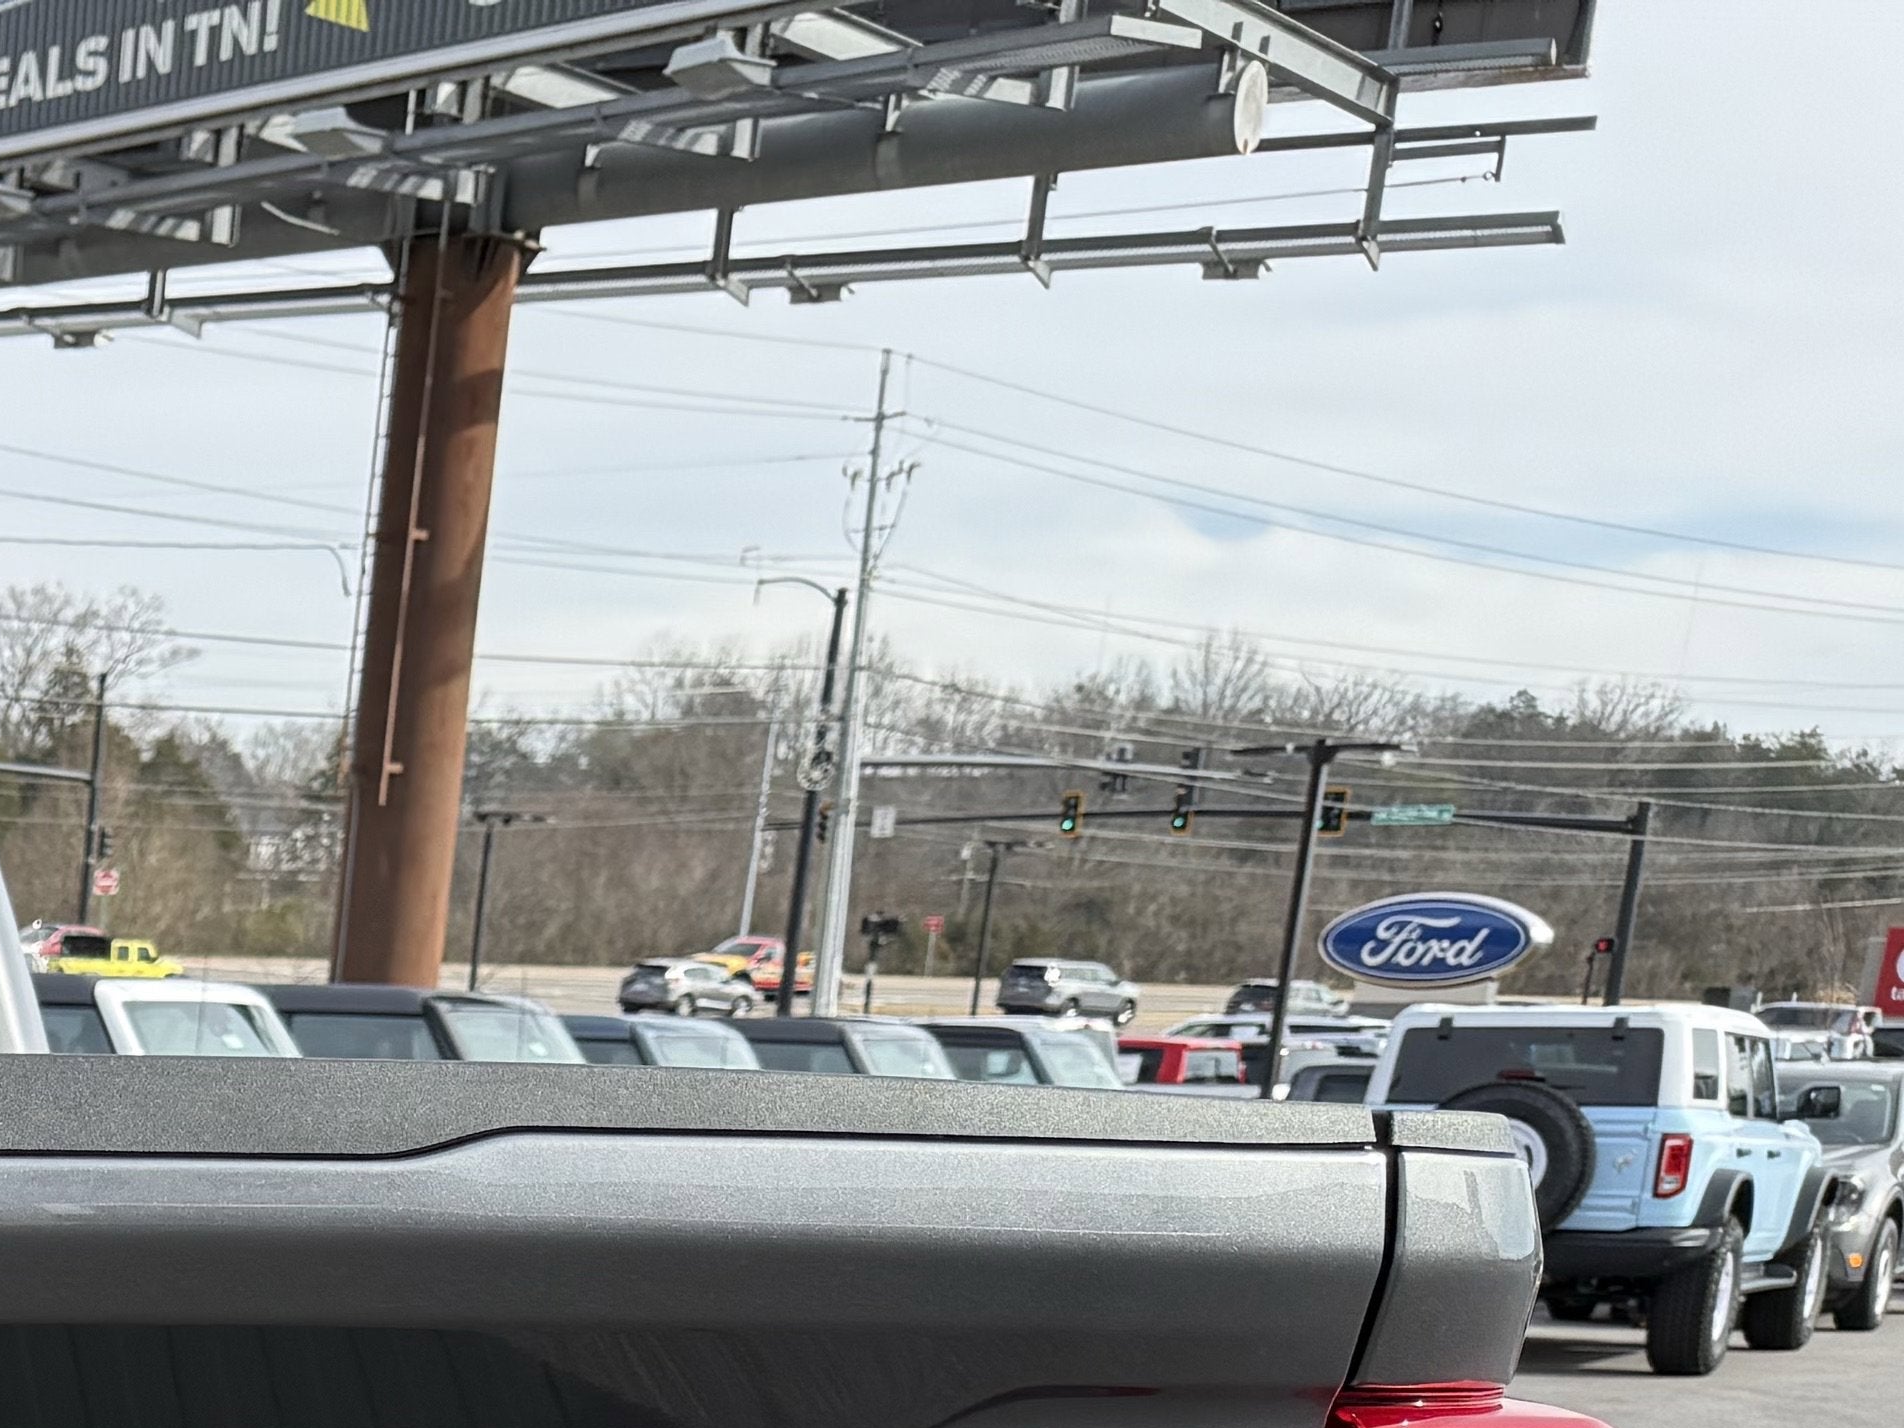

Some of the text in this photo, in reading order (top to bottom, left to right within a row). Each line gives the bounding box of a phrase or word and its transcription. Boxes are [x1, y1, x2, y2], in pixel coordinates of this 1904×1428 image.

[118, 19, 175, 83] IN
[184, 0, 281, 67] TN!
[1360, 914, 1491, 967] Ford
